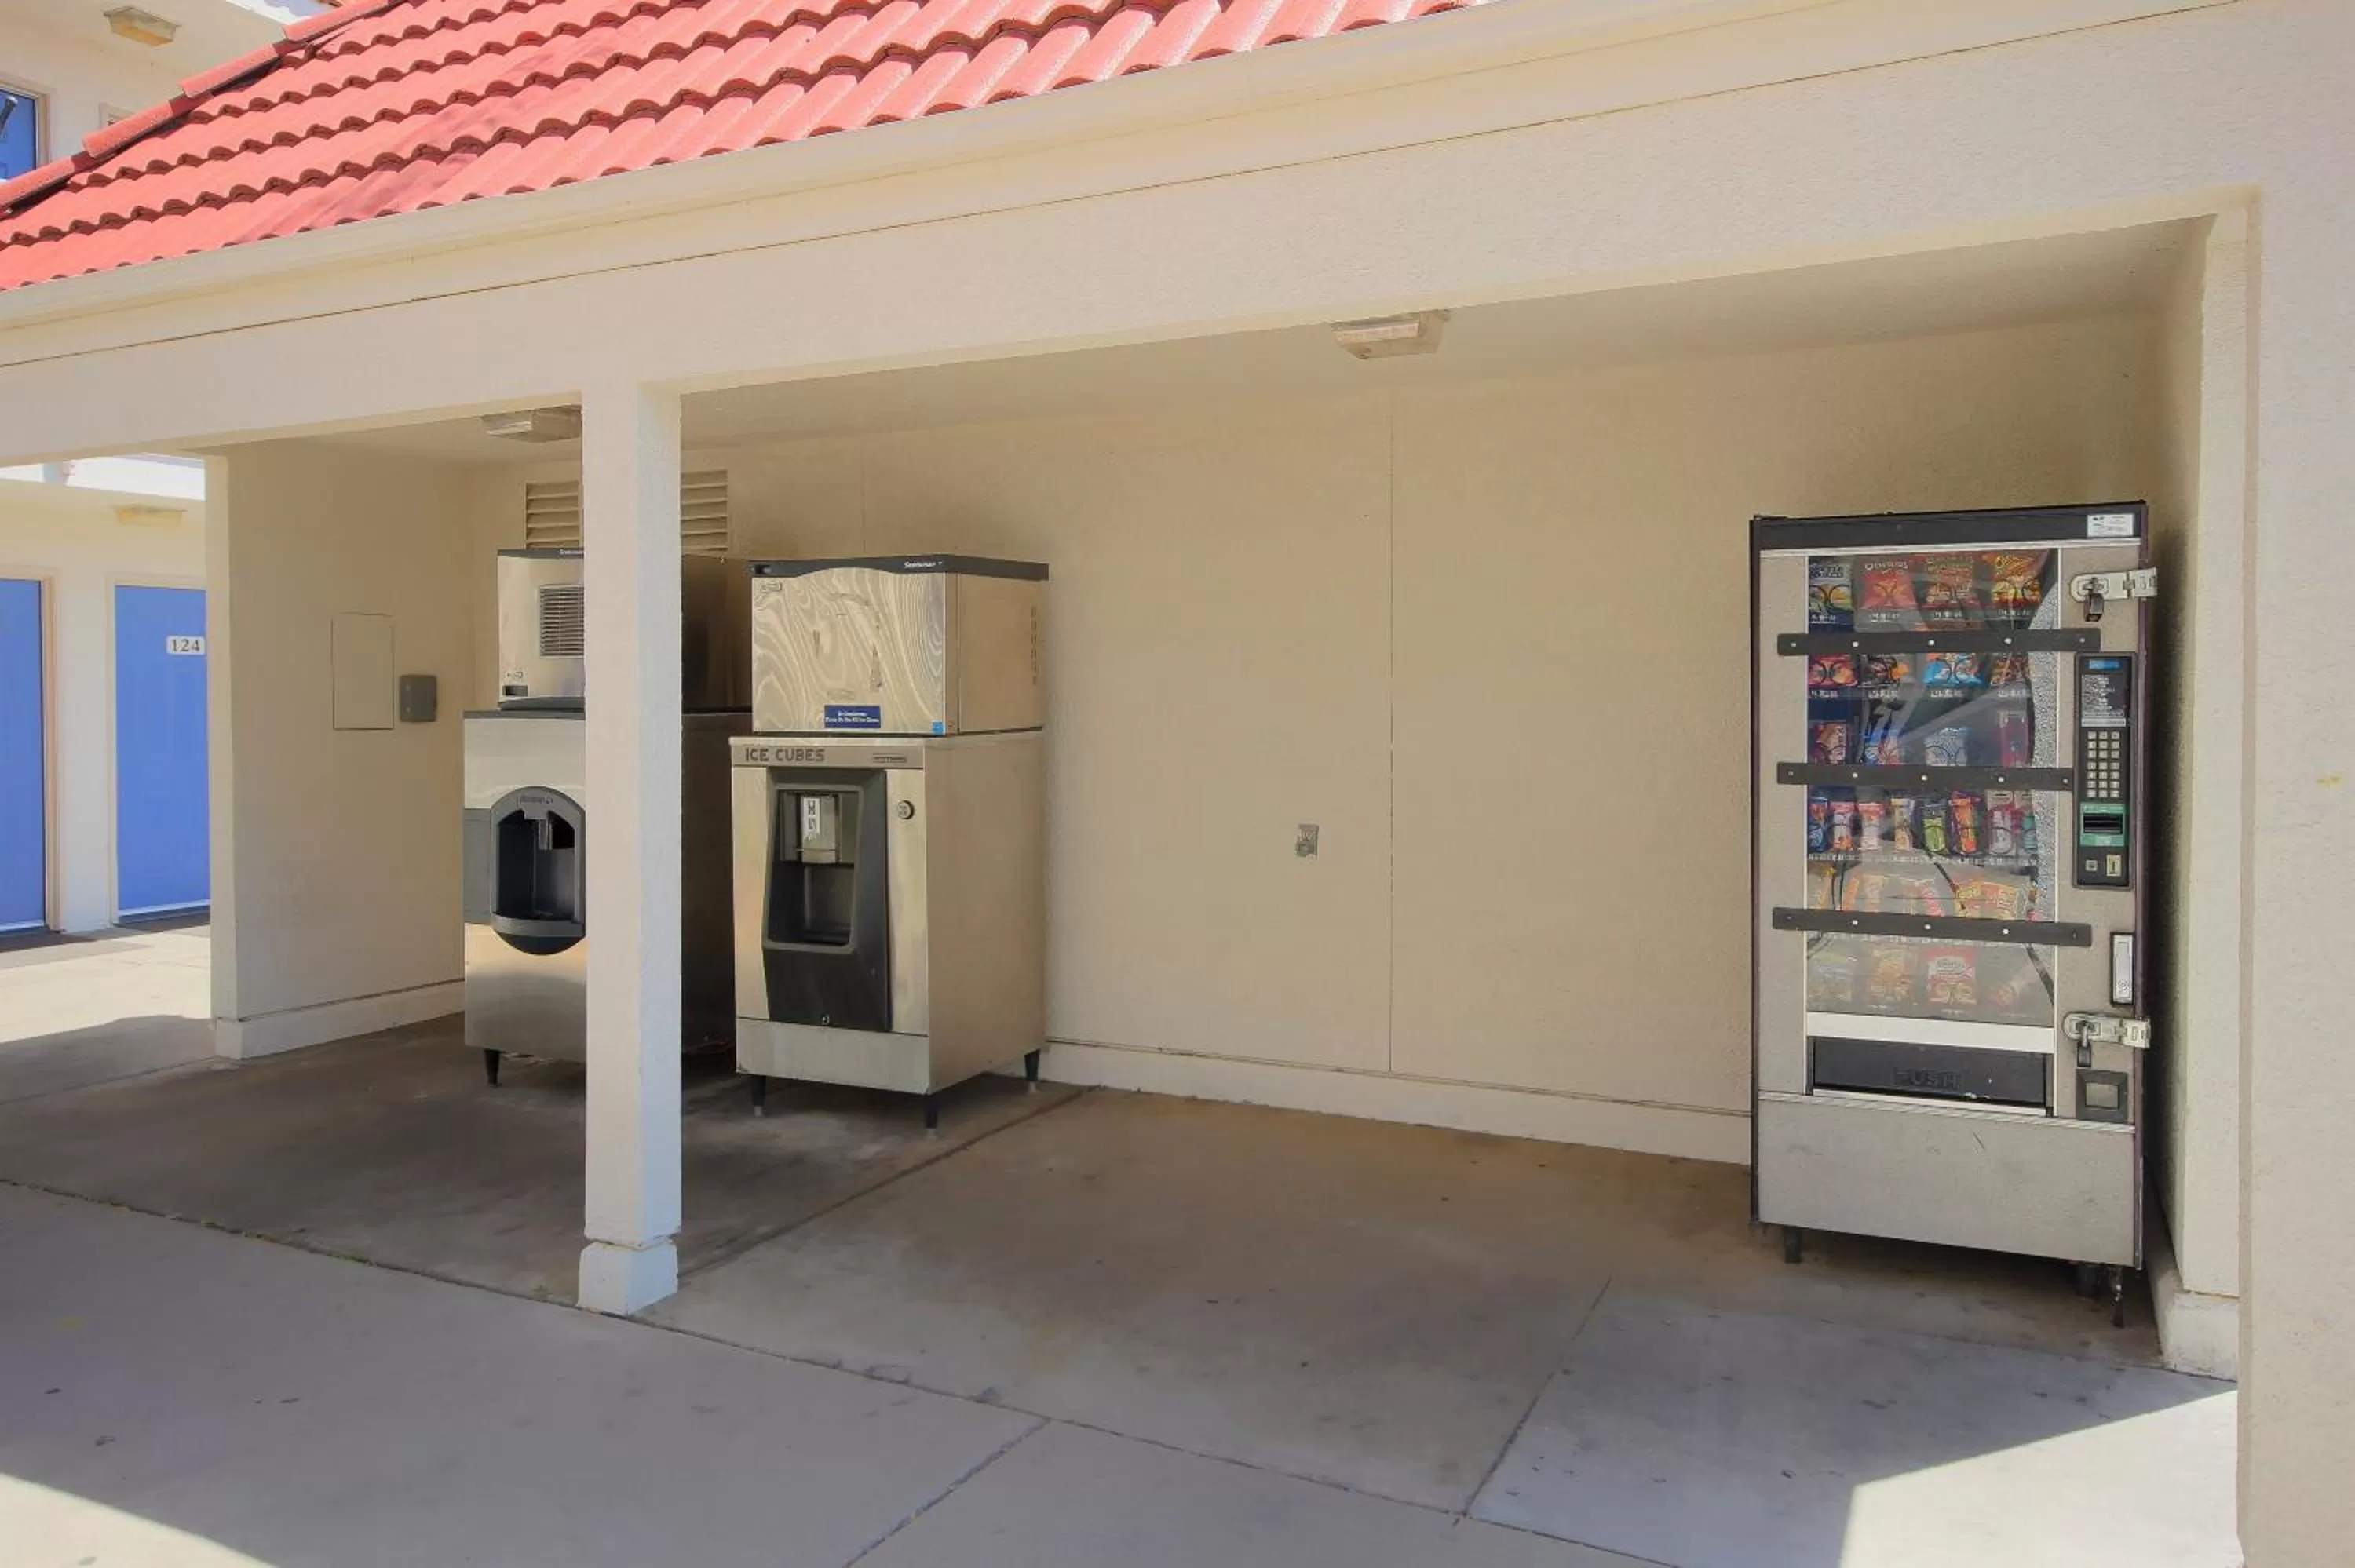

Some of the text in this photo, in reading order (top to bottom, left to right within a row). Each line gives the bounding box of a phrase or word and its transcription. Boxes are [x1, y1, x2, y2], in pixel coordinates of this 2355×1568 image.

[172, 638, 200, 652] 124
[745, 748, 825, 762] ICE CUBES
